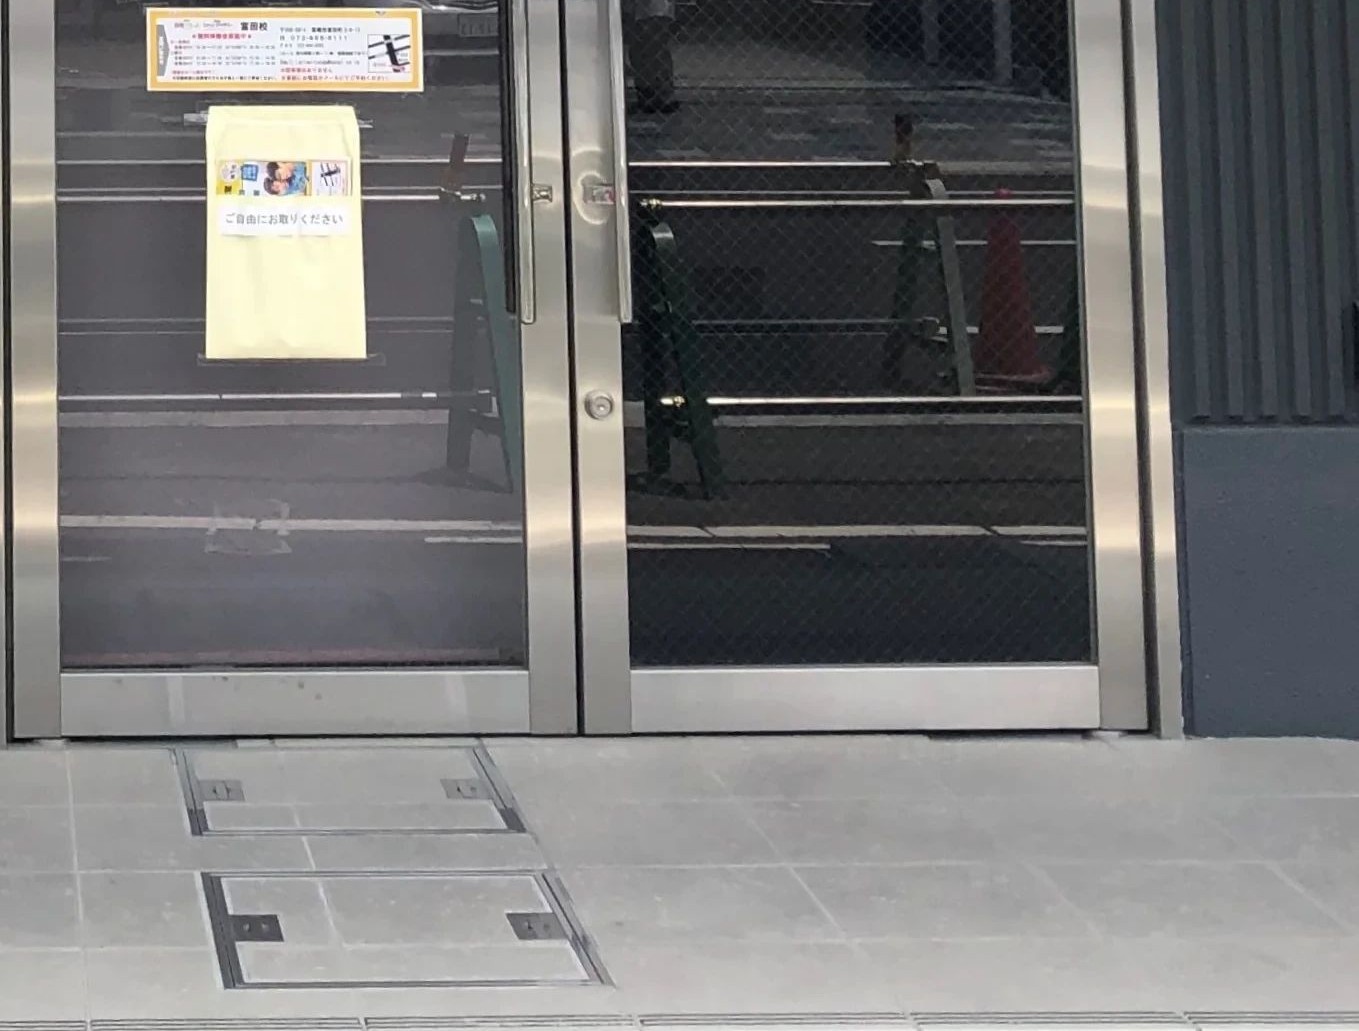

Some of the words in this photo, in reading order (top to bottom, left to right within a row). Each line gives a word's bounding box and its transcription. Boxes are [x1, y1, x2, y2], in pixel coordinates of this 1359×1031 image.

[225, 212, 344, 226] ご自由にお取りください
